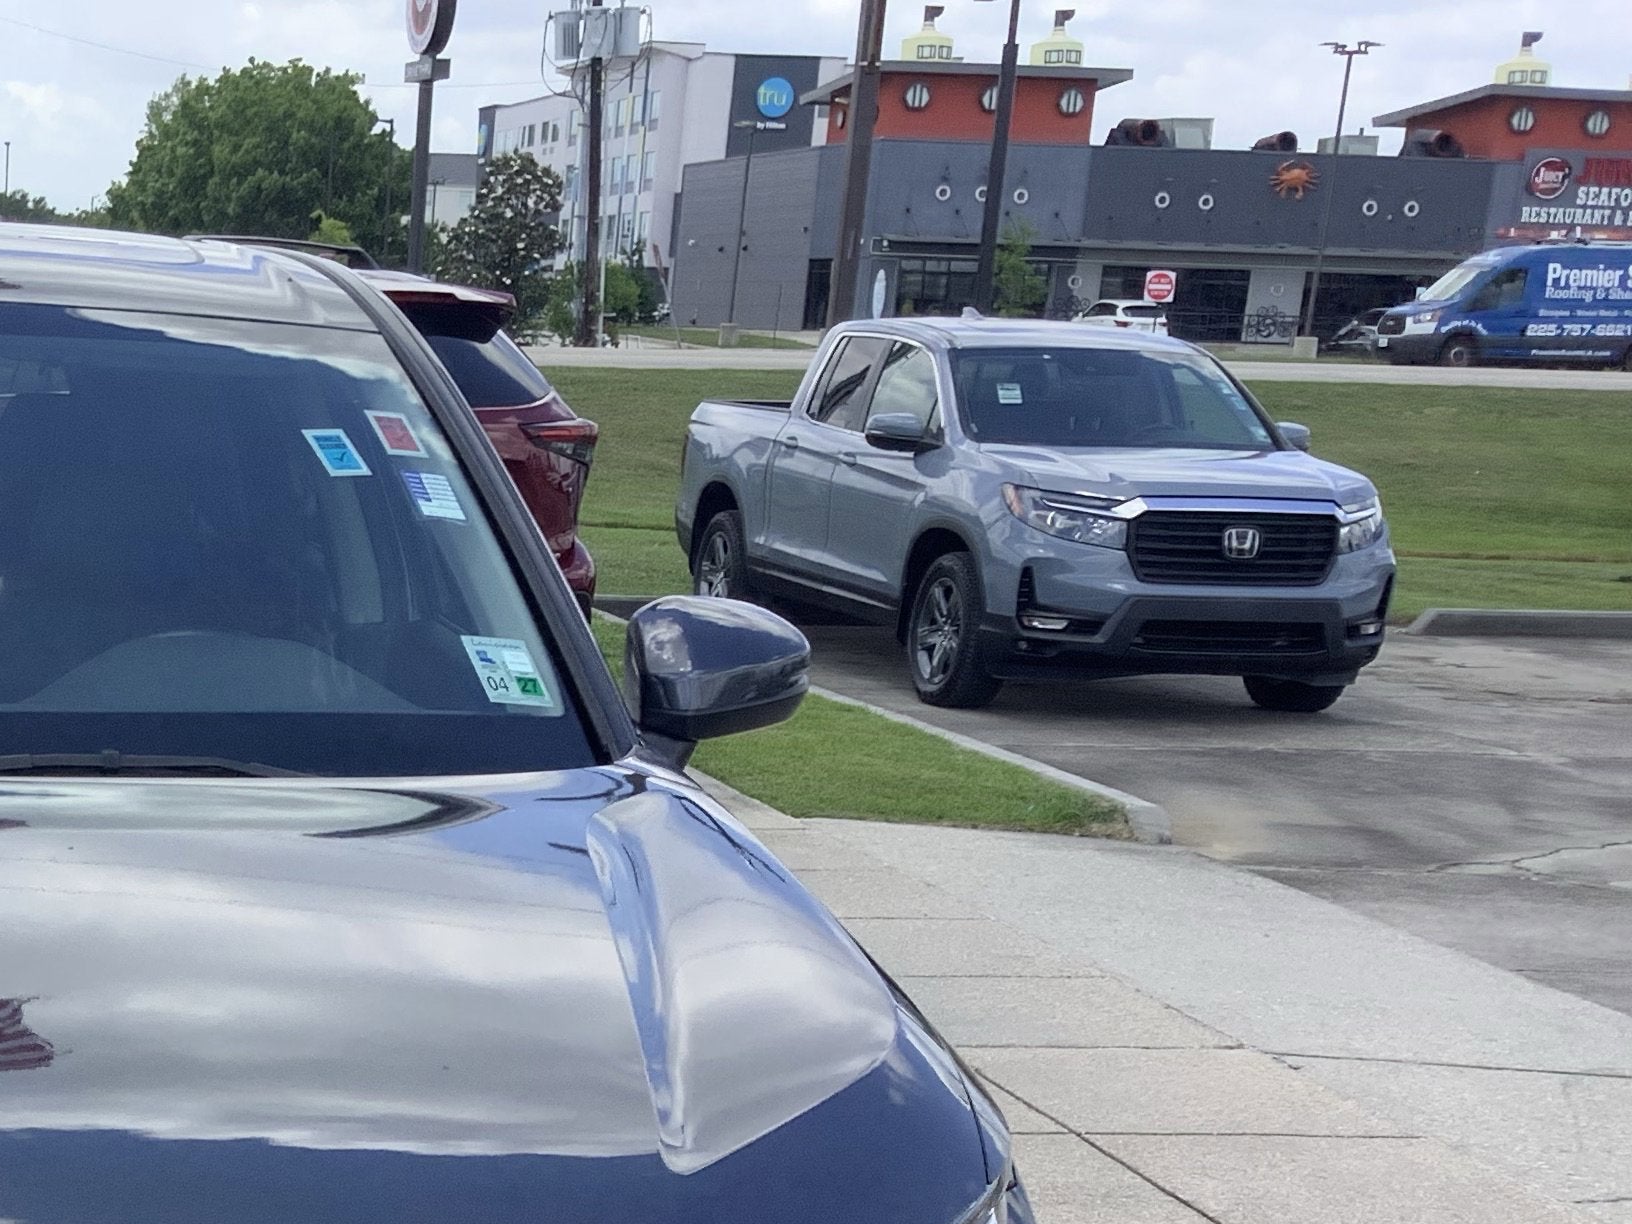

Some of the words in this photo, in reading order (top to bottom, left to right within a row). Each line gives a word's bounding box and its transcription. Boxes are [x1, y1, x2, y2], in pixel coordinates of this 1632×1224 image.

[758, 86, 786, 105] tru
[1521, 206, 1612, 225] RESTAURANT
[1546, 263, 1625, 288] Premier
[486, 675, 510, 692] 04
